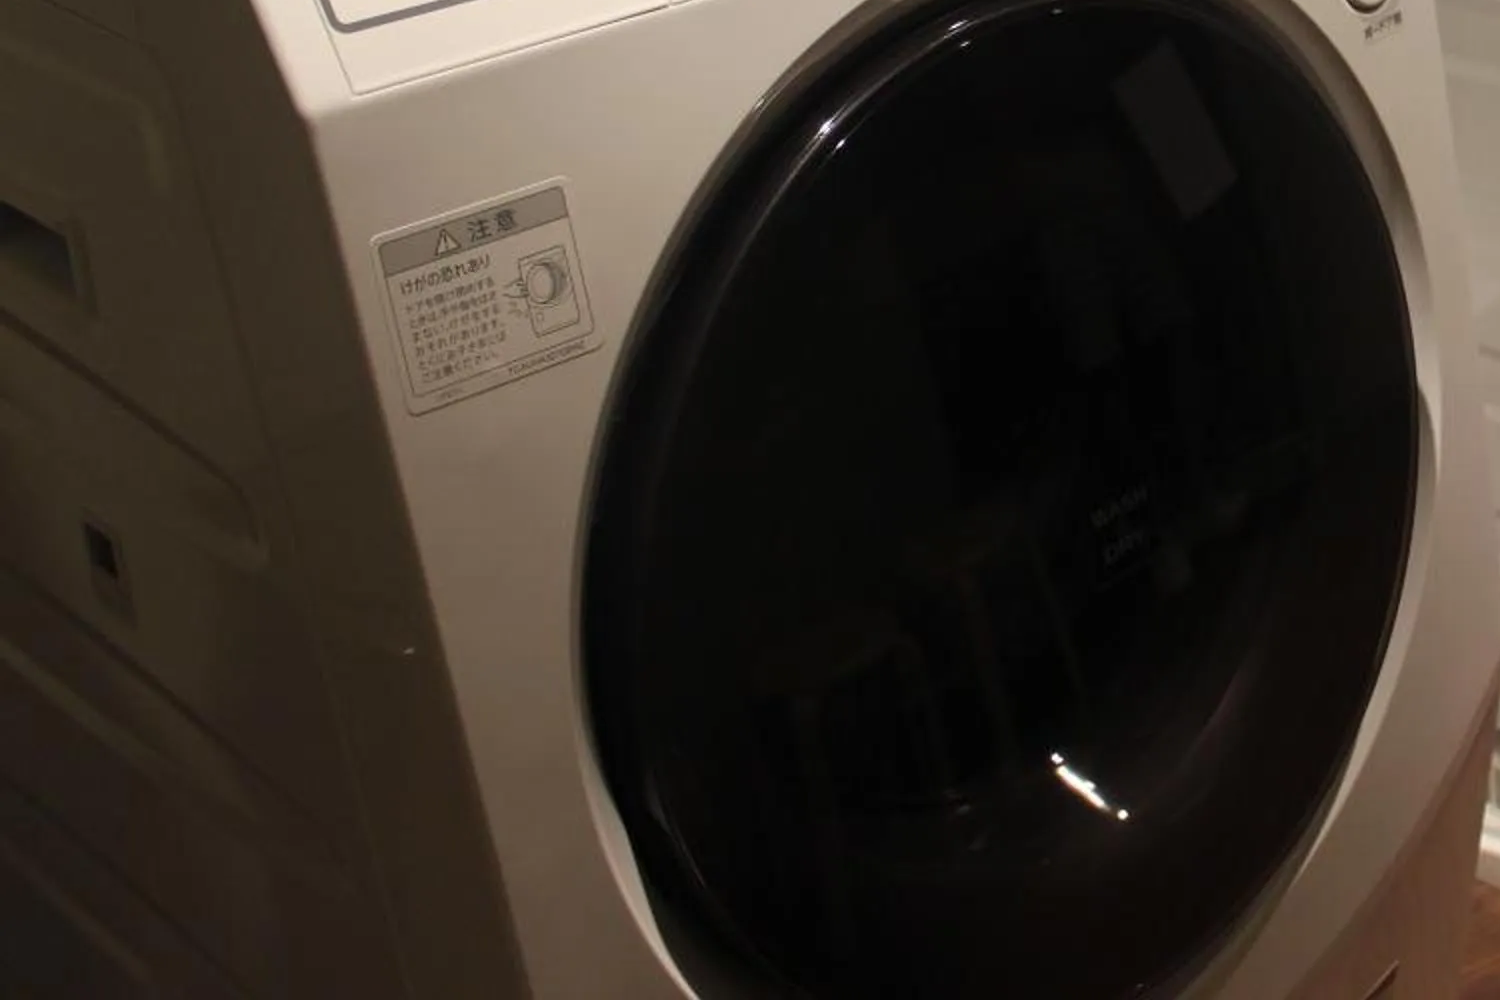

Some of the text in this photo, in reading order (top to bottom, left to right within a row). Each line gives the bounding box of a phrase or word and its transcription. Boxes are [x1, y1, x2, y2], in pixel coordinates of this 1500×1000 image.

[467, 208, 516, 242] 注意
[400, 254, 490, 295] けがの恐れあり
